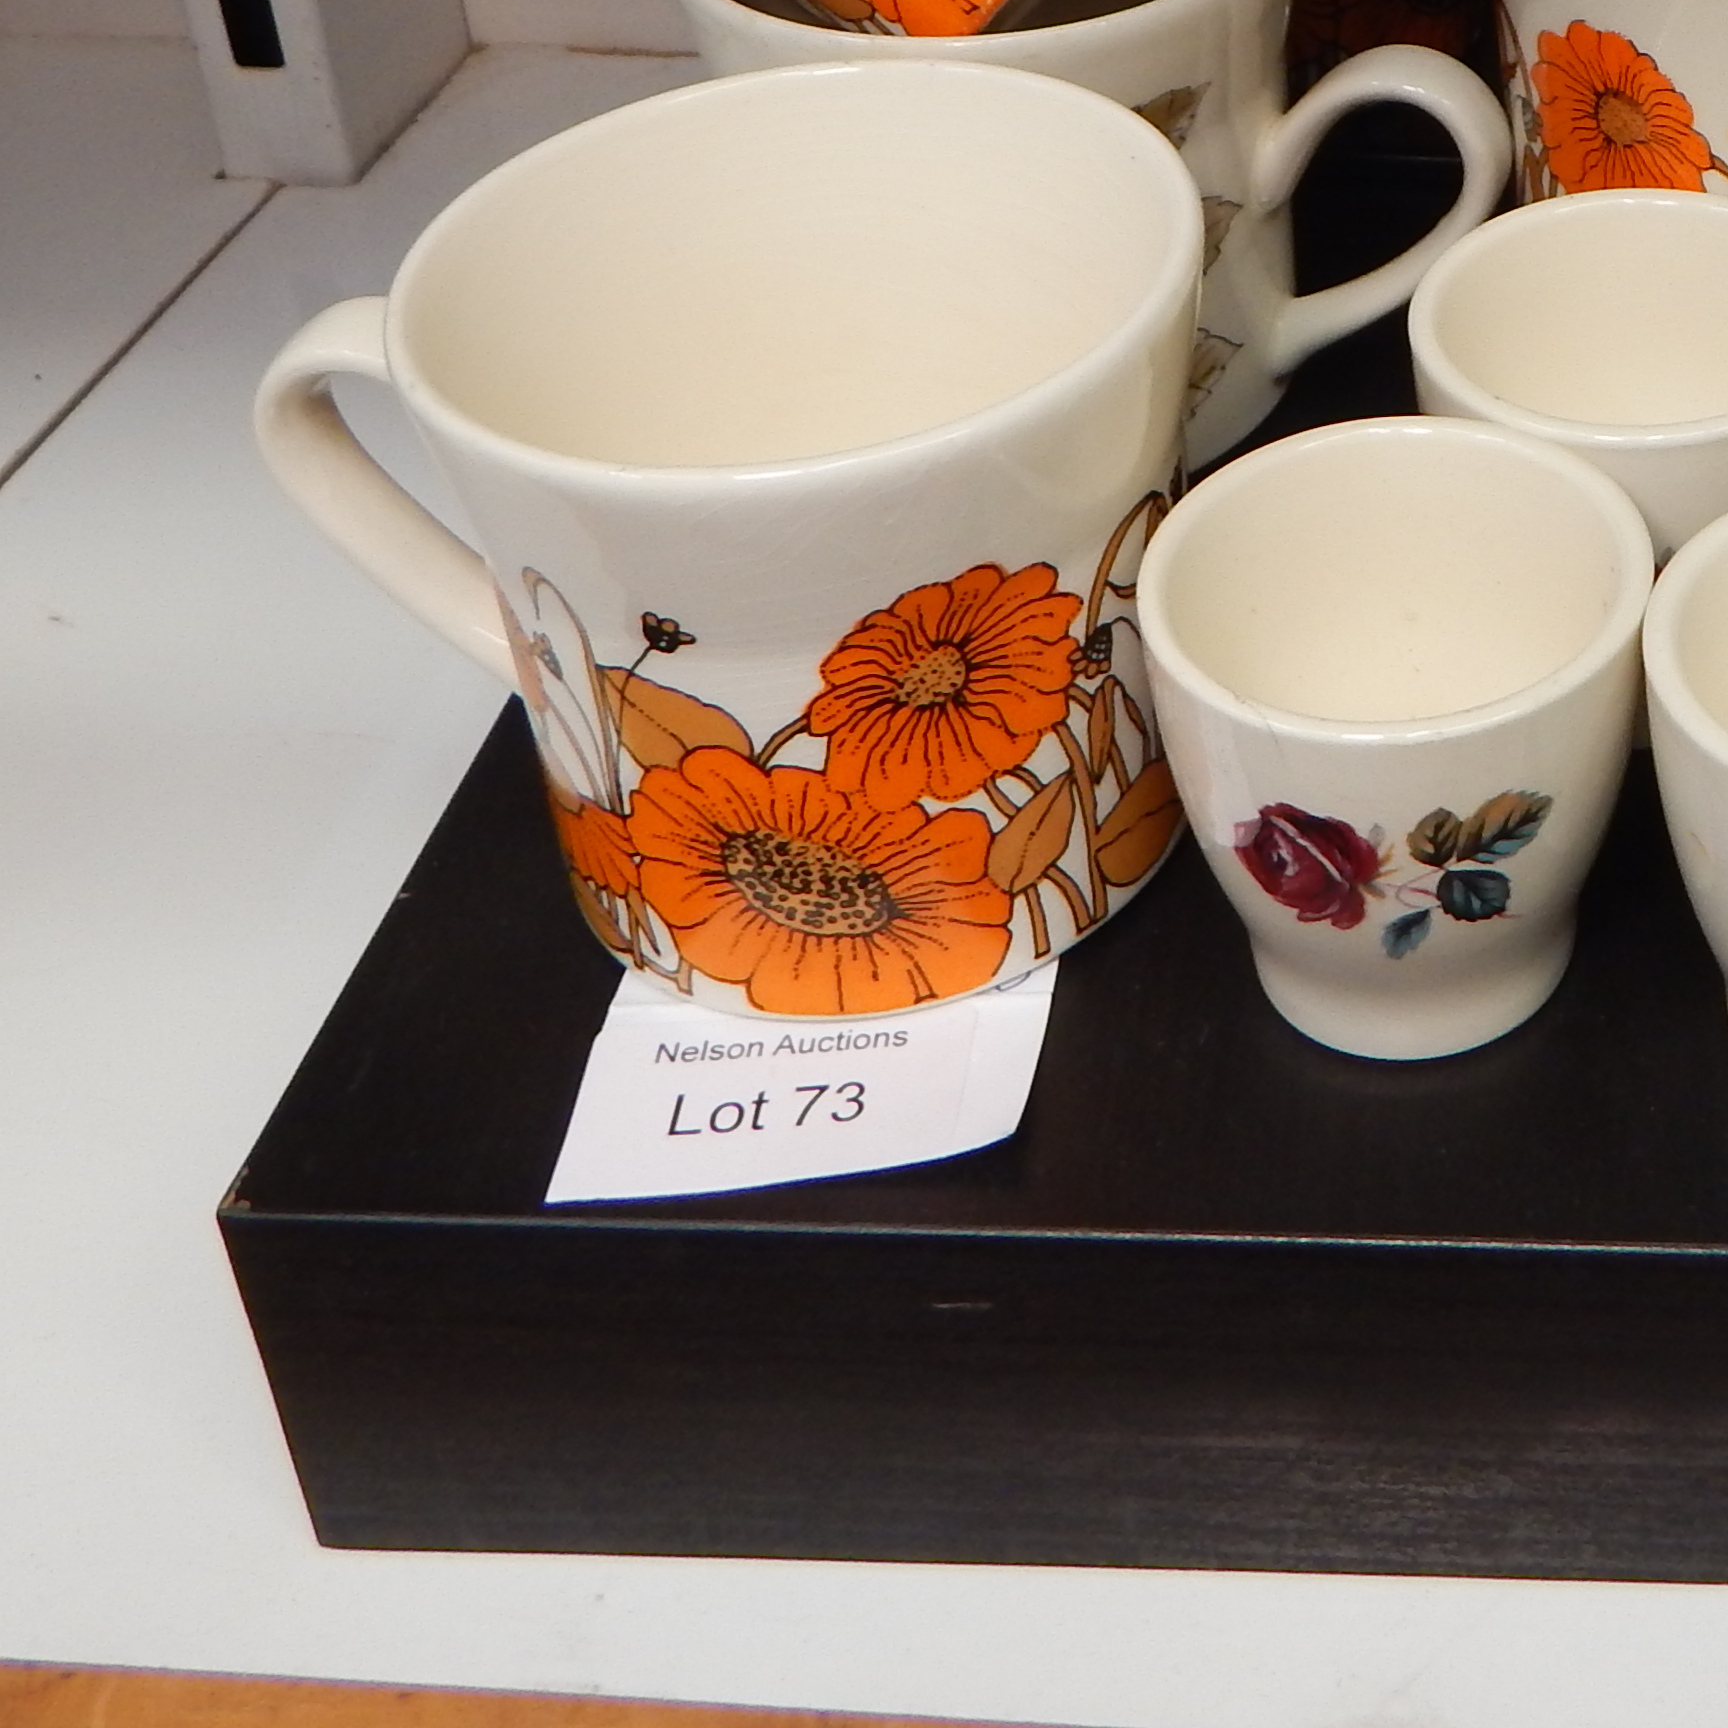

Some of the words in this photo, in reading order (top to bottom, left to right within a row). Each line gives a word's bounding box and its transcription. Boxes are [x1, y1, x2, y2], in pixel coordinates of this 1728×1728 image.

[655, 1041, 764, 1063] Nelson
[773, 1030, 908, 1055] Auctions
[668, 1092, 768, 1135] Lot
[795, 1082, 865, 1126] 73
